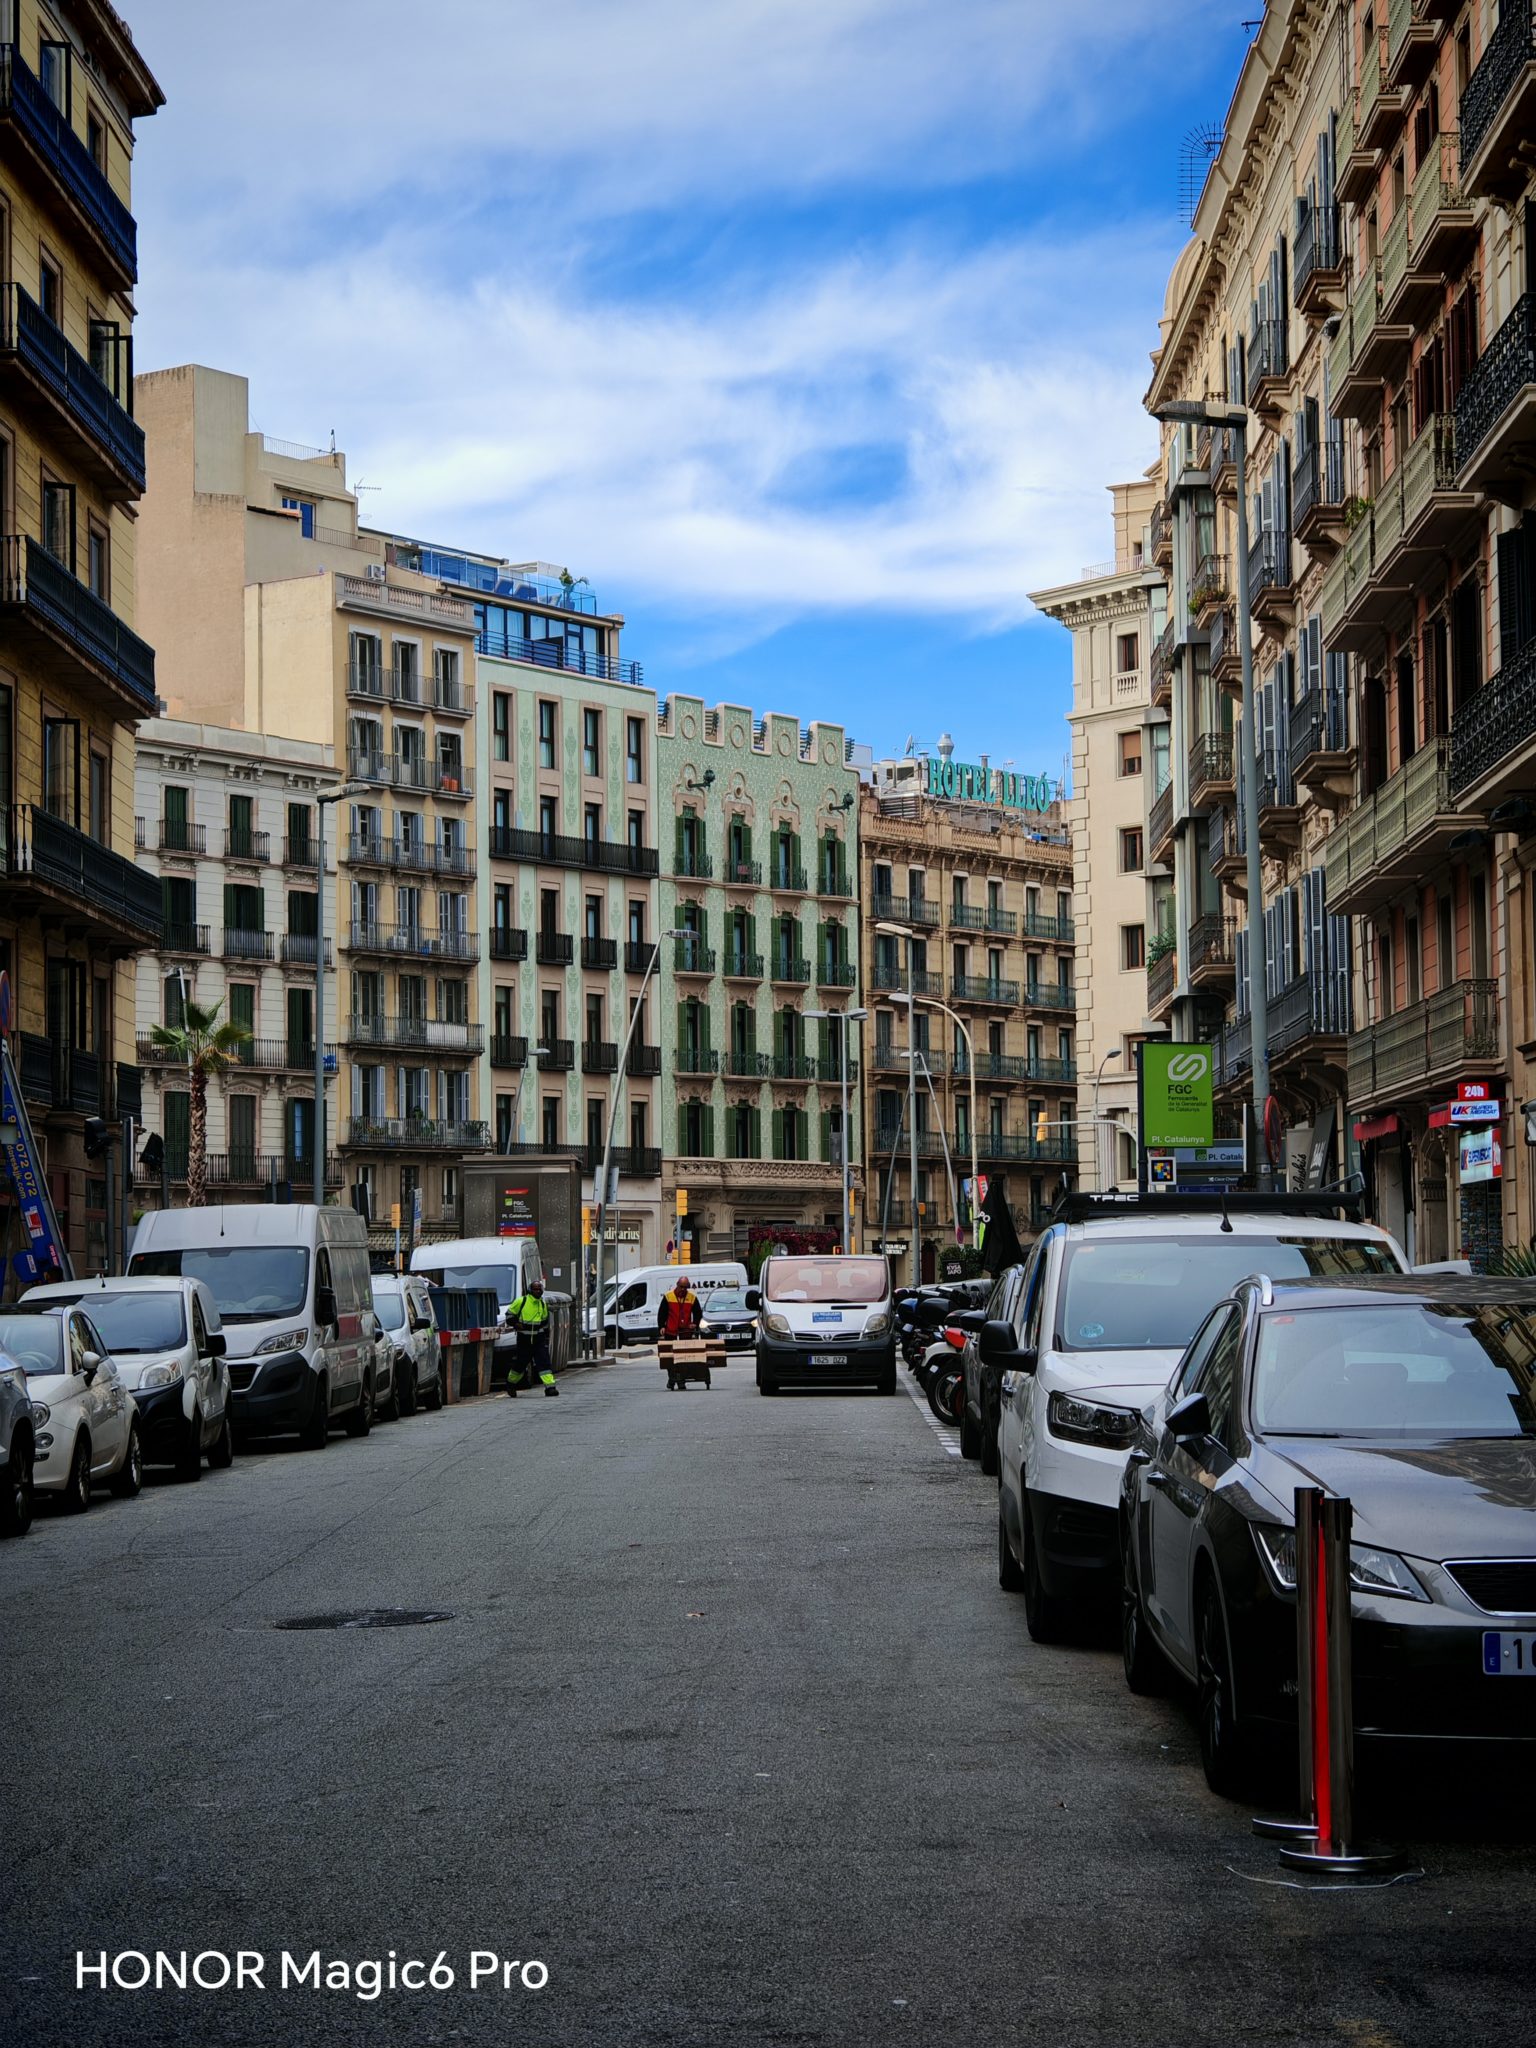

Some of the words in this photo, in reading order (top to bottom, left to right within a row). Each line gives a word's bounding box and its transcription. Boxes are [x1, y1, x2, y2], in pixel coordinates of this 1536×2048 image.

[927, 758, 996, 803] HOTEL
[1001, 771, 1050, 814] LLEÓ
[1168, 1084, 1192, 1095] FGC
[1464, 1085, 1484, 1097] 24h
[1452, 1105, 1471, 1115] UK
[1152, 1135, 1162, 1143] Pl.
[1164, 1135, 1205, 1144] Catalunya
[1208, 1153, 1218, 1161] Pl.
[1220, 1153, 1245, 1161] Catalu
